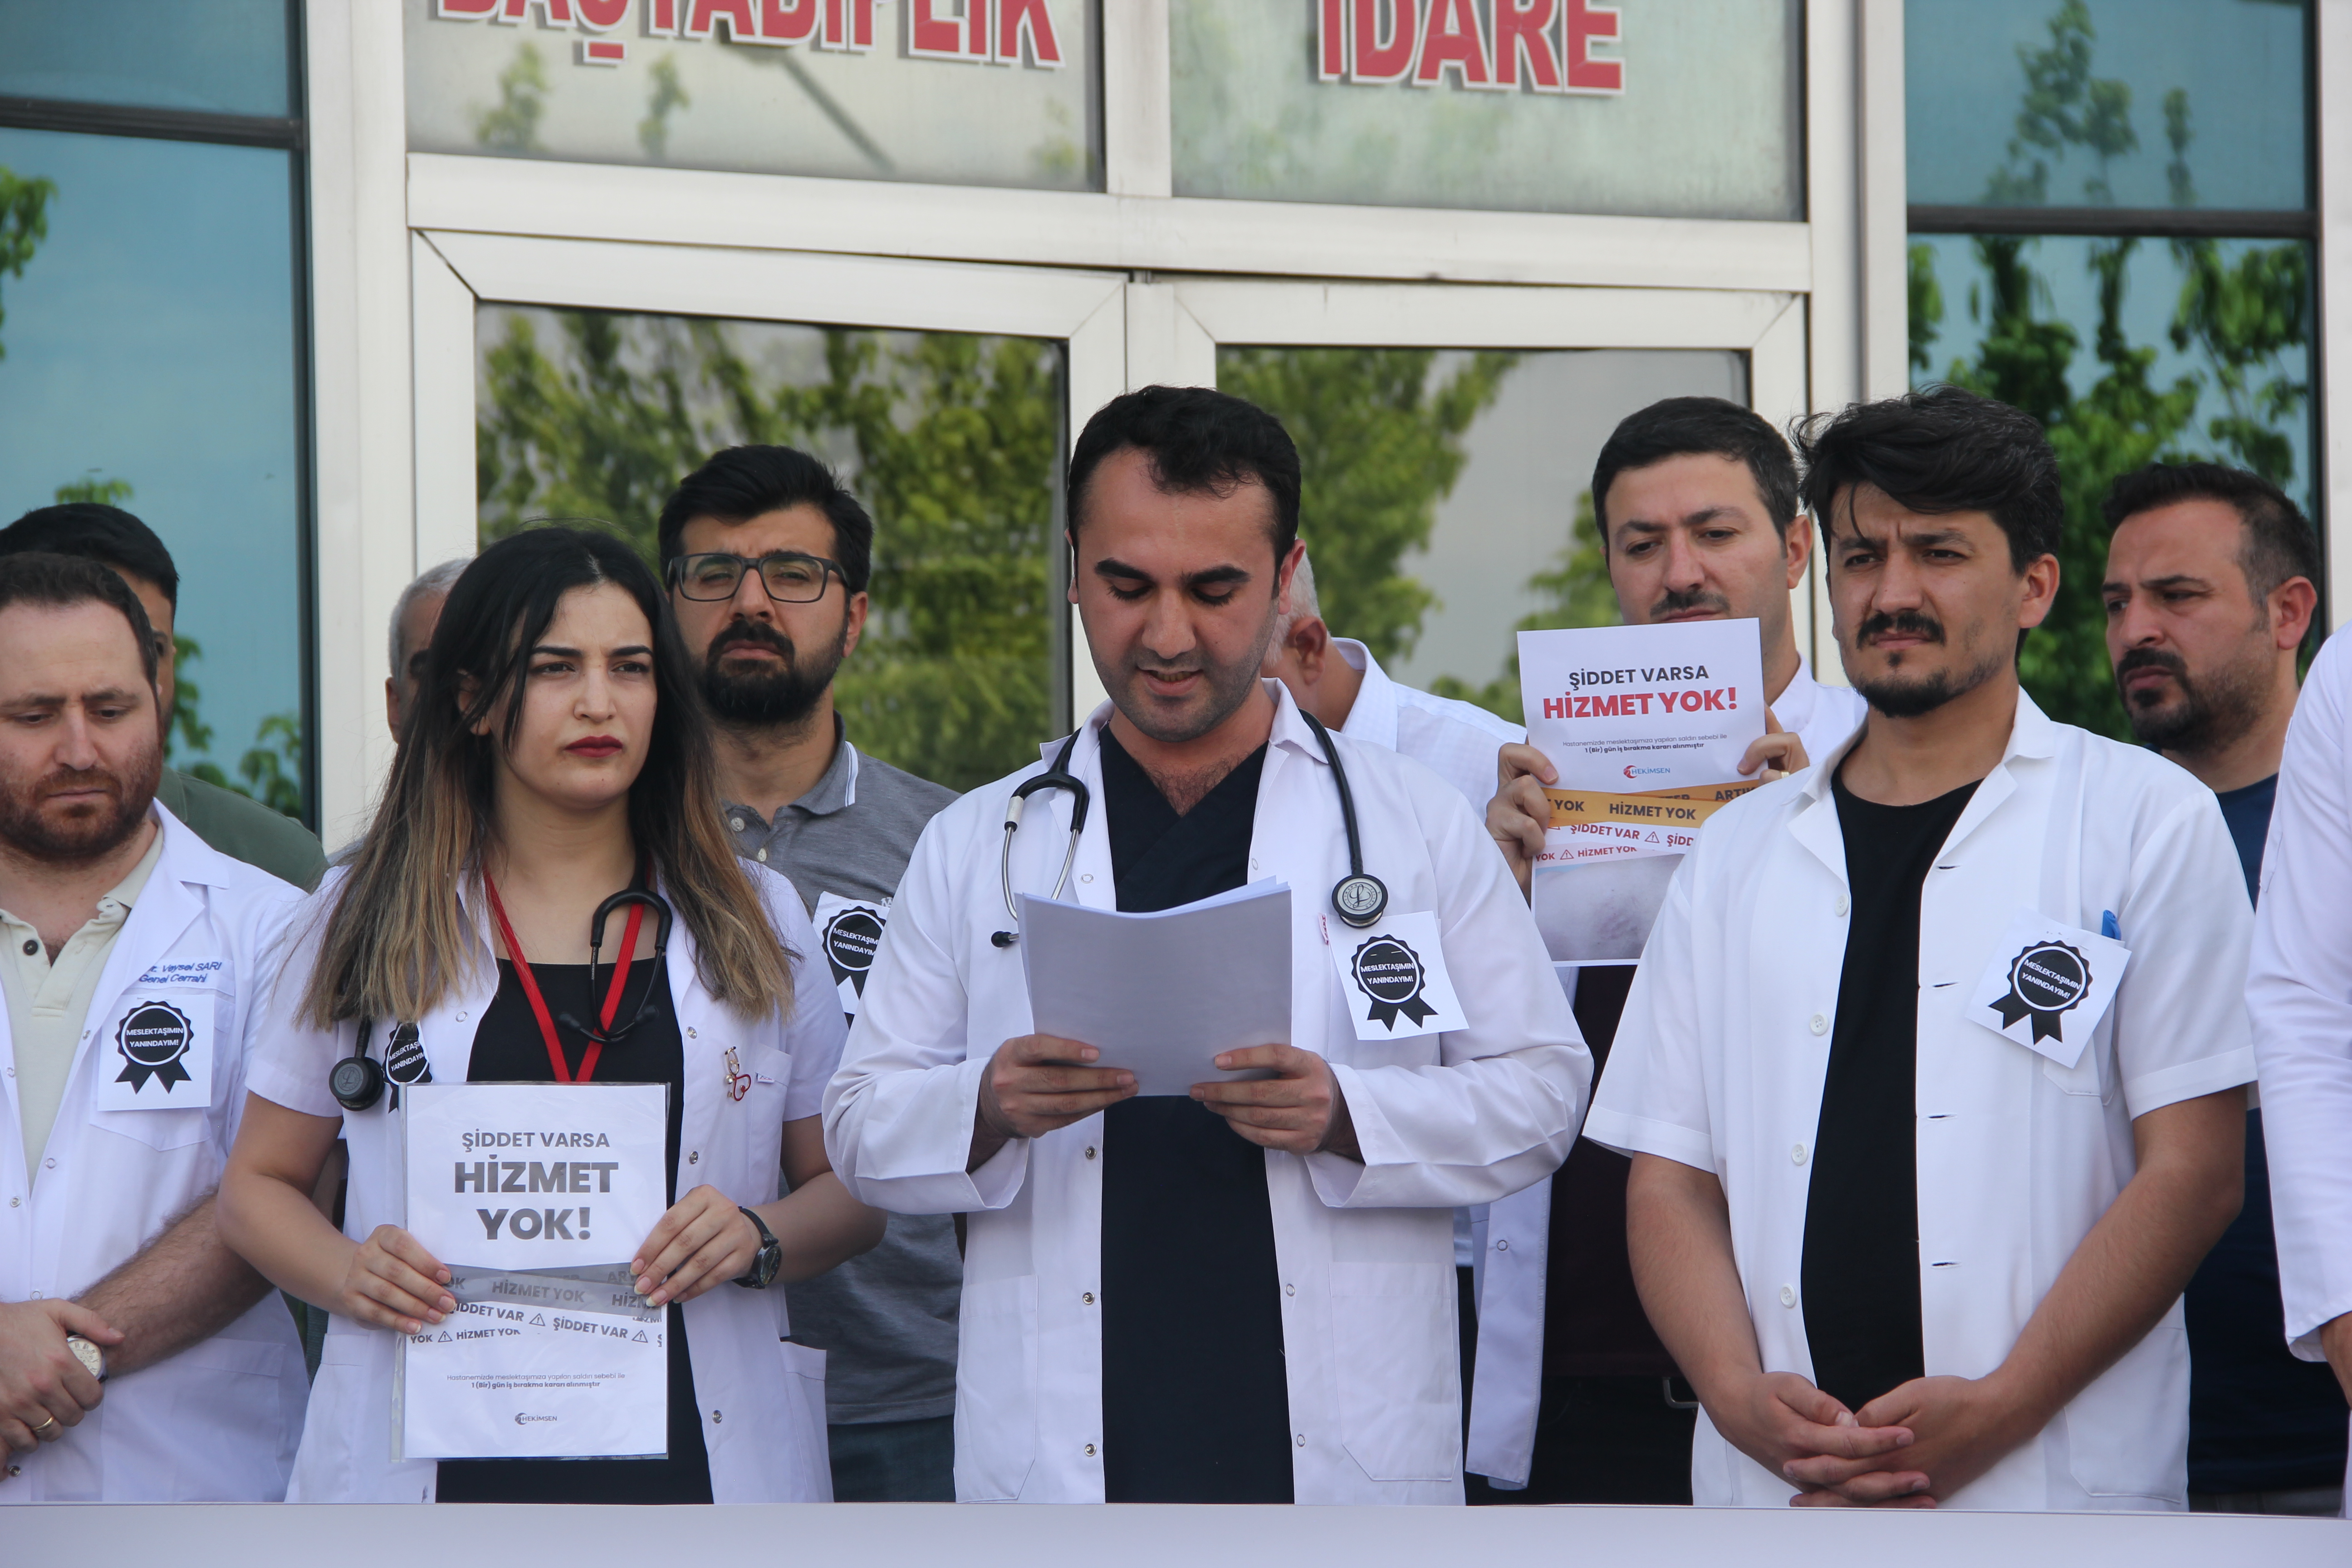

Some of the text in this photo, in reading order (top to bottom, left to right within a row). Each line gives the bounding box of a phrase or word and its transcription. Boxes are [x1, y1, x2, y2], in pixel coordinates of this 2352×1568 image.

[1569, 665, 1709, 690] ŞİDDET VARSA
[1544, 687, 1738, 719] HİZMET YOK!
[1589, 746, 1603, 754] (Bir)
[1554, 799, 1696, 820] YOK HİZMET YOK
[1615, 827, 1640, 840] VAR
[1666, 833, 1694, 847] ŞİDD
[1535, 853, 1555, 862] YOK
[1578, 848, 1614, 858] HİZMET
[833, 927, 878, 945] MESLEKTAŞIM
[833, 940, 876, 956] YANINDAYIM
[195, 961, 222, 971] SARI
[1360, 962, 1415, 972] MESLEKTAŞIMIN
[2024, 959, 2082, 990] MESLEKTAŞIMIN
[139, 973, 208, 983] Genel Cerrahi
[1367, 975, 1414, 985] YANINDAYIM!
[2022, 972, 2071, 999] YANINDAYIM!
[126, 1027, 183, 1036] MESLEKTAŞIMIN
[129, 1039, 179, 1048] YANINDAYIM!
[462, 1128, 610, 1153] ŞİDDET VARSA
[455, 1154, 619, 1193] HİZMET
[476, 1207, 591, 1240] YOK!
[492, 1279, 550, 1298] HİZMET
[553, 1288, 586, 1303] YOK
[496, 1308, 524, 1322] VAR
[553, 1316, 598, 1334] ŞİDDET
[600, 1325, 628, 1338] VAR
[410, 1334, 433, 1344] YOK
[456, 1326, 496, 1340] HİZMET
[475, 1381, 491, 1390] (Bir)
[506, 1381, 512, 1390] iş
